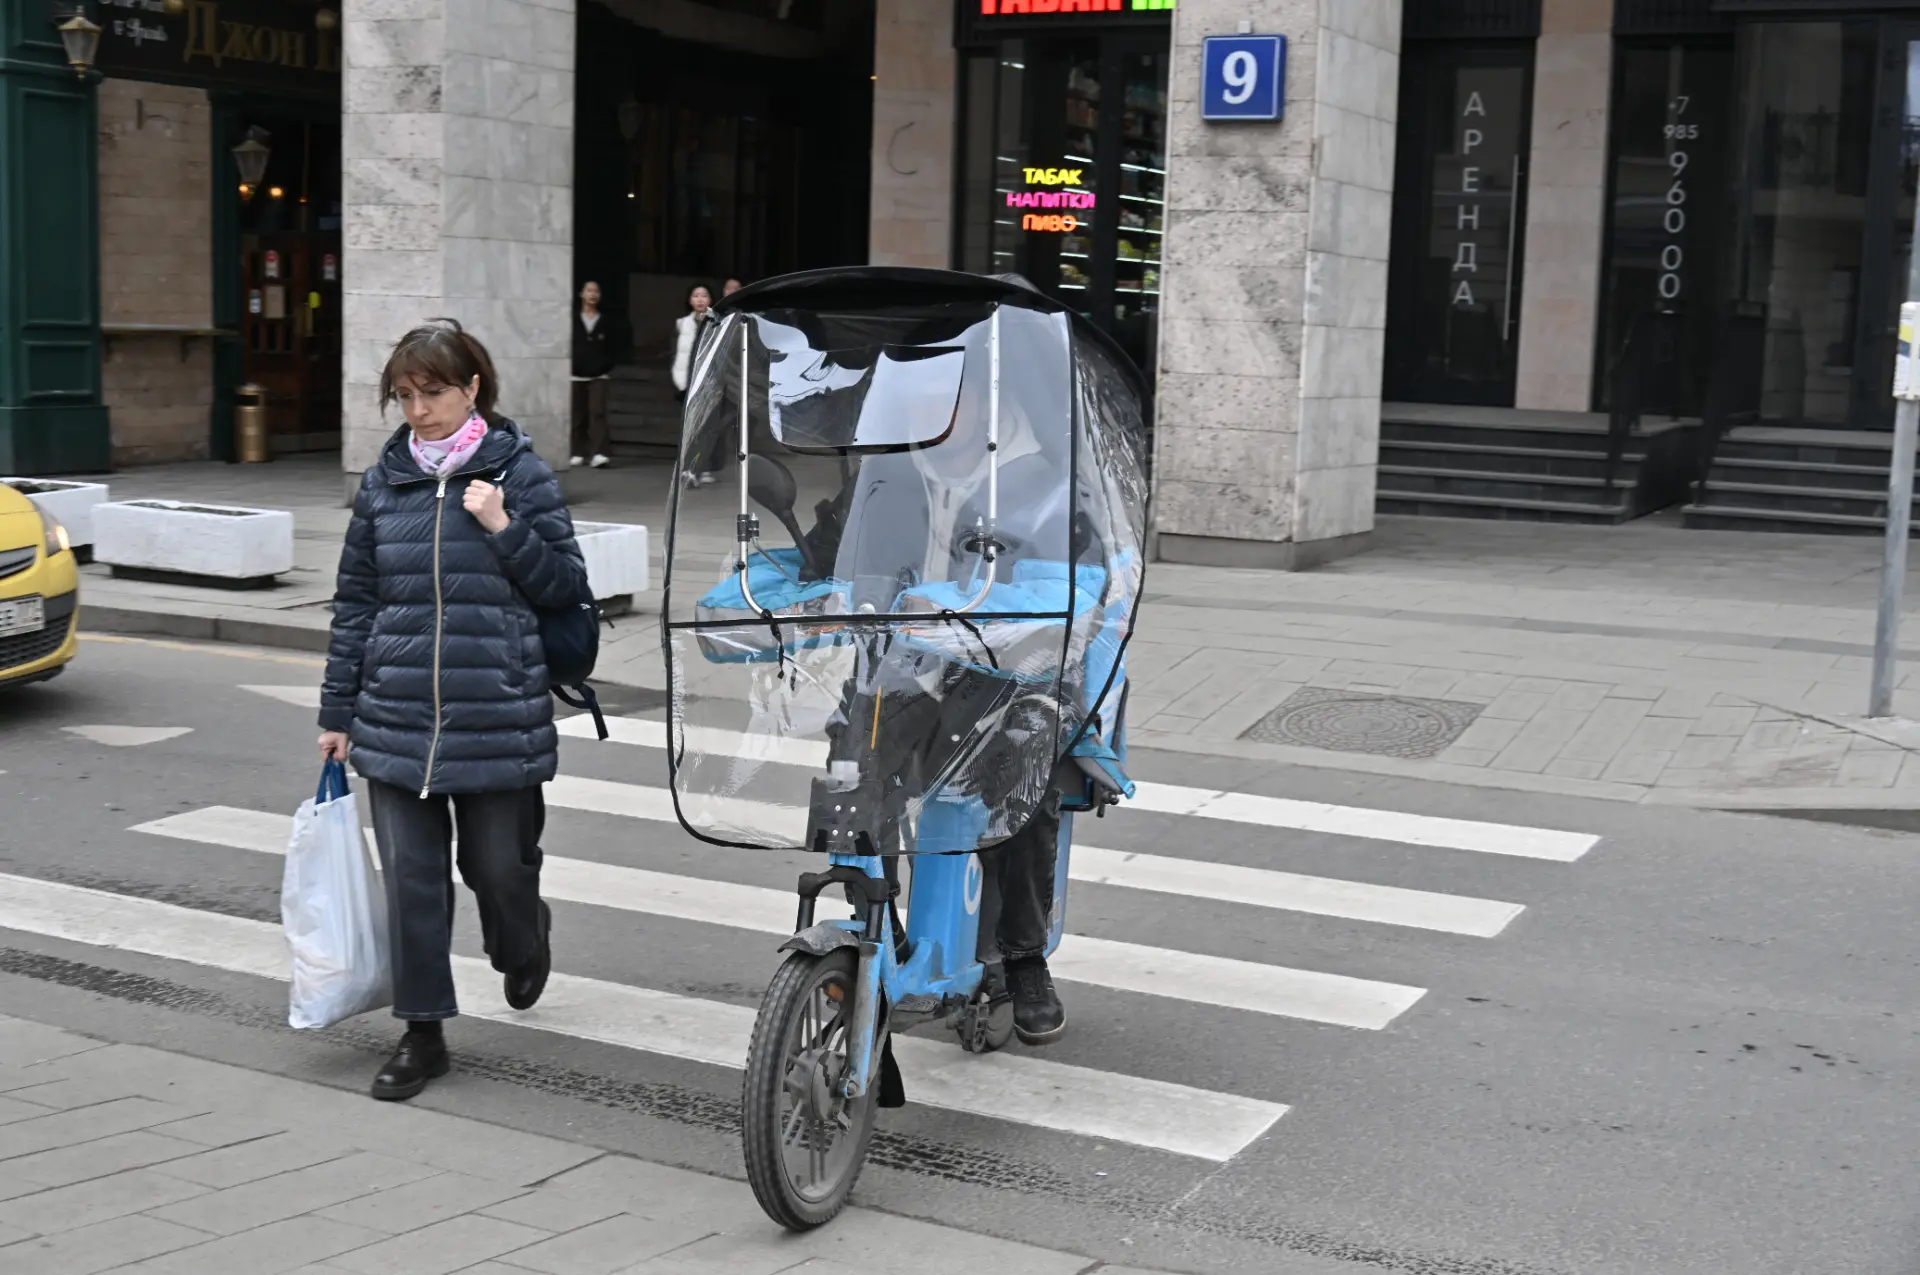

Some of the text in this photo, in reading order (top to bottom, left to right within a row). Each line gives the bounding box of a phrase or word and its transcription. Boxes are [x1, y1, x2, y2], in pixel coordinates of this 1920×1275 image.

[1222, 50, 1258, 105] 9
[1663, 124, 1699, 139] 985
[1022, 168, 1083, 185] ТАБАК
[1006, 192, 1096, 208] НАПИТКИ
[1452, 91, 1486, 305] АРЕНДА
[1022, 214, 1077, 232] ПИВО
